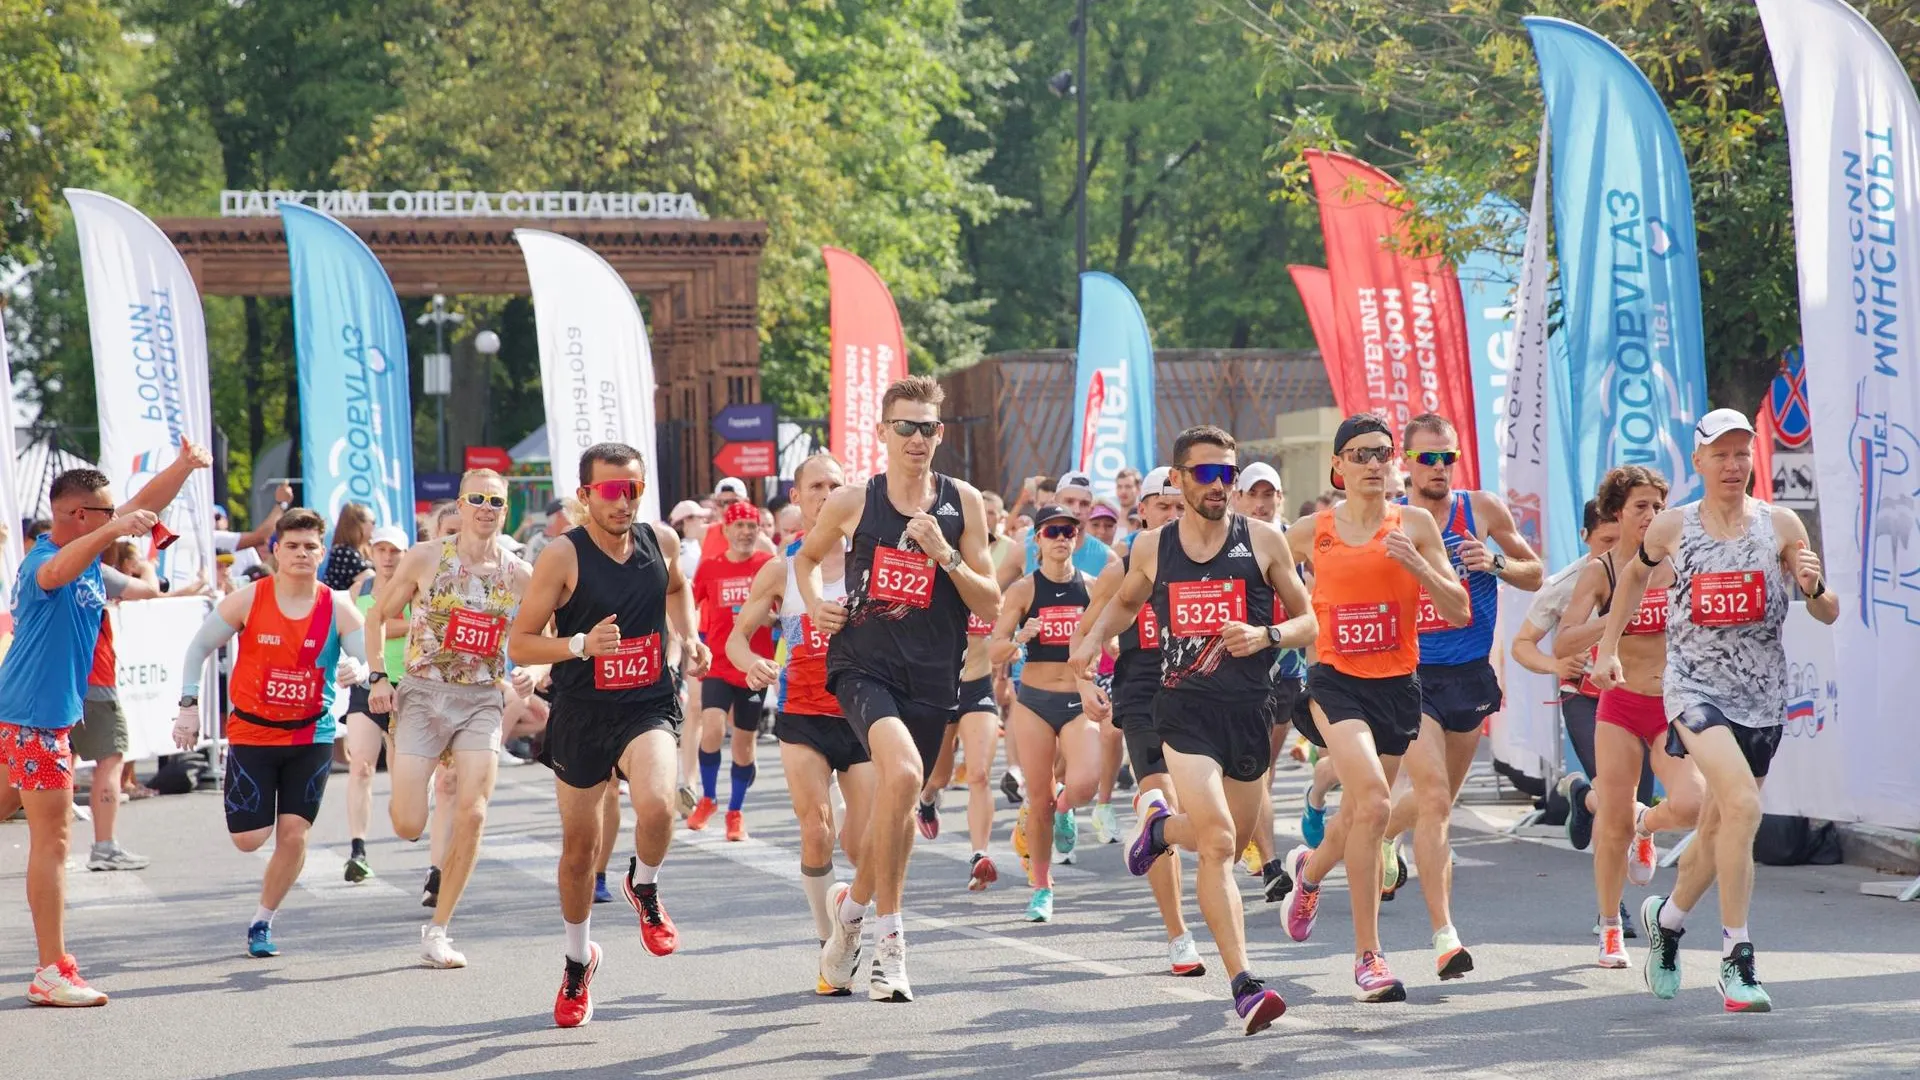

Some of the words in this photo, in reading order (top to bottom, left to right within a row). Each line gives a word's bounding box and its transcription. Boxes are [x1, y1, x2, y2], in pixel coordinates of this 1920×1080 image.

[220, 190, 306, 217] ПАРК
[387, 190, 493, 218] ОЛЕГА
[501, 190, 700, 218] СТЕПАНОВА
[877, 568, 929, 595] 5322
[722, 587, 750, 601] 5175
[1700, 593, 1749, 615] 5312
[1176, 602, 1231, 625] 5325
[455, 626, 489, 647] 5311
[1338, 623, 1383, 645] 5321
[603, 656, 649, 679] 5142
[266, 681, 307, 700] 5233
